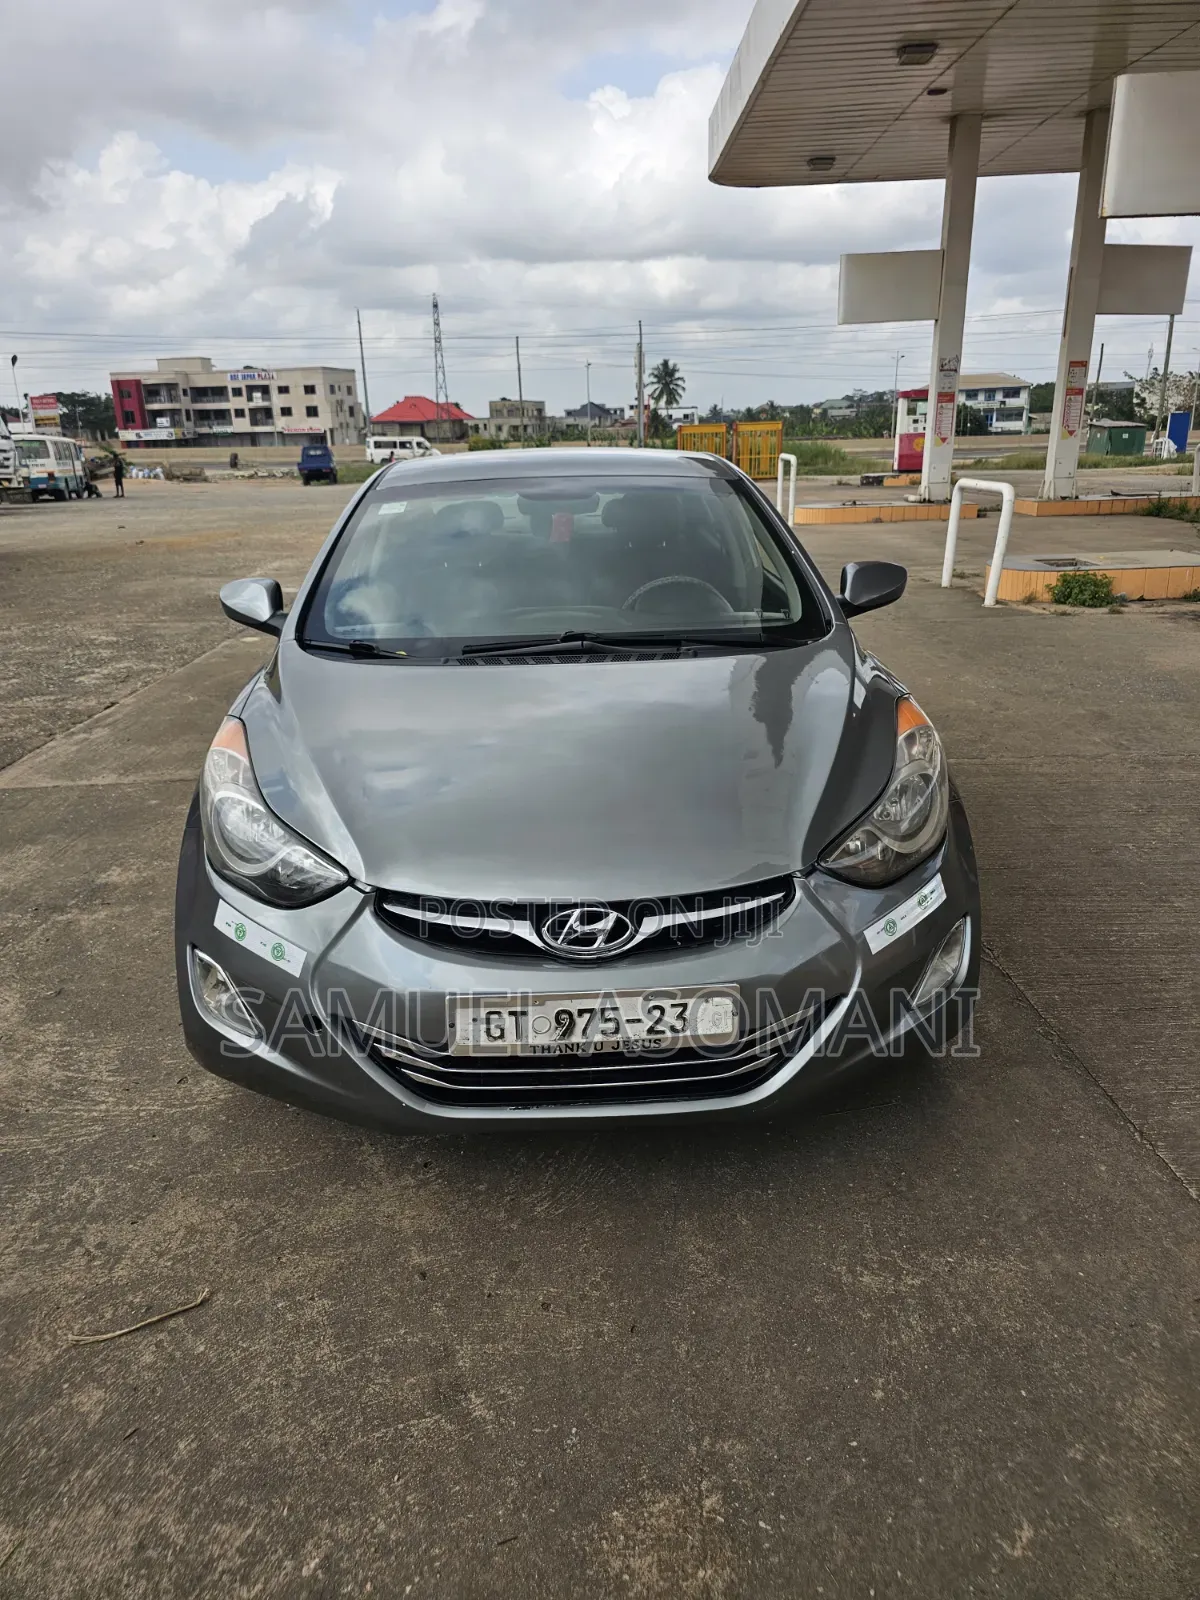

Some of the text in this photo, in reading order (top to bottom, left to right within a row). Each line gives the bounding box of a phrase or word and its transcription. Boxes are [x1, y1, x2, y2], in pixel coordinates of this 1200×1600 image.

[485, 1002, 689, 1043] GT 975-23
[529, 1037, 662, 1055] THANK U JESUS
